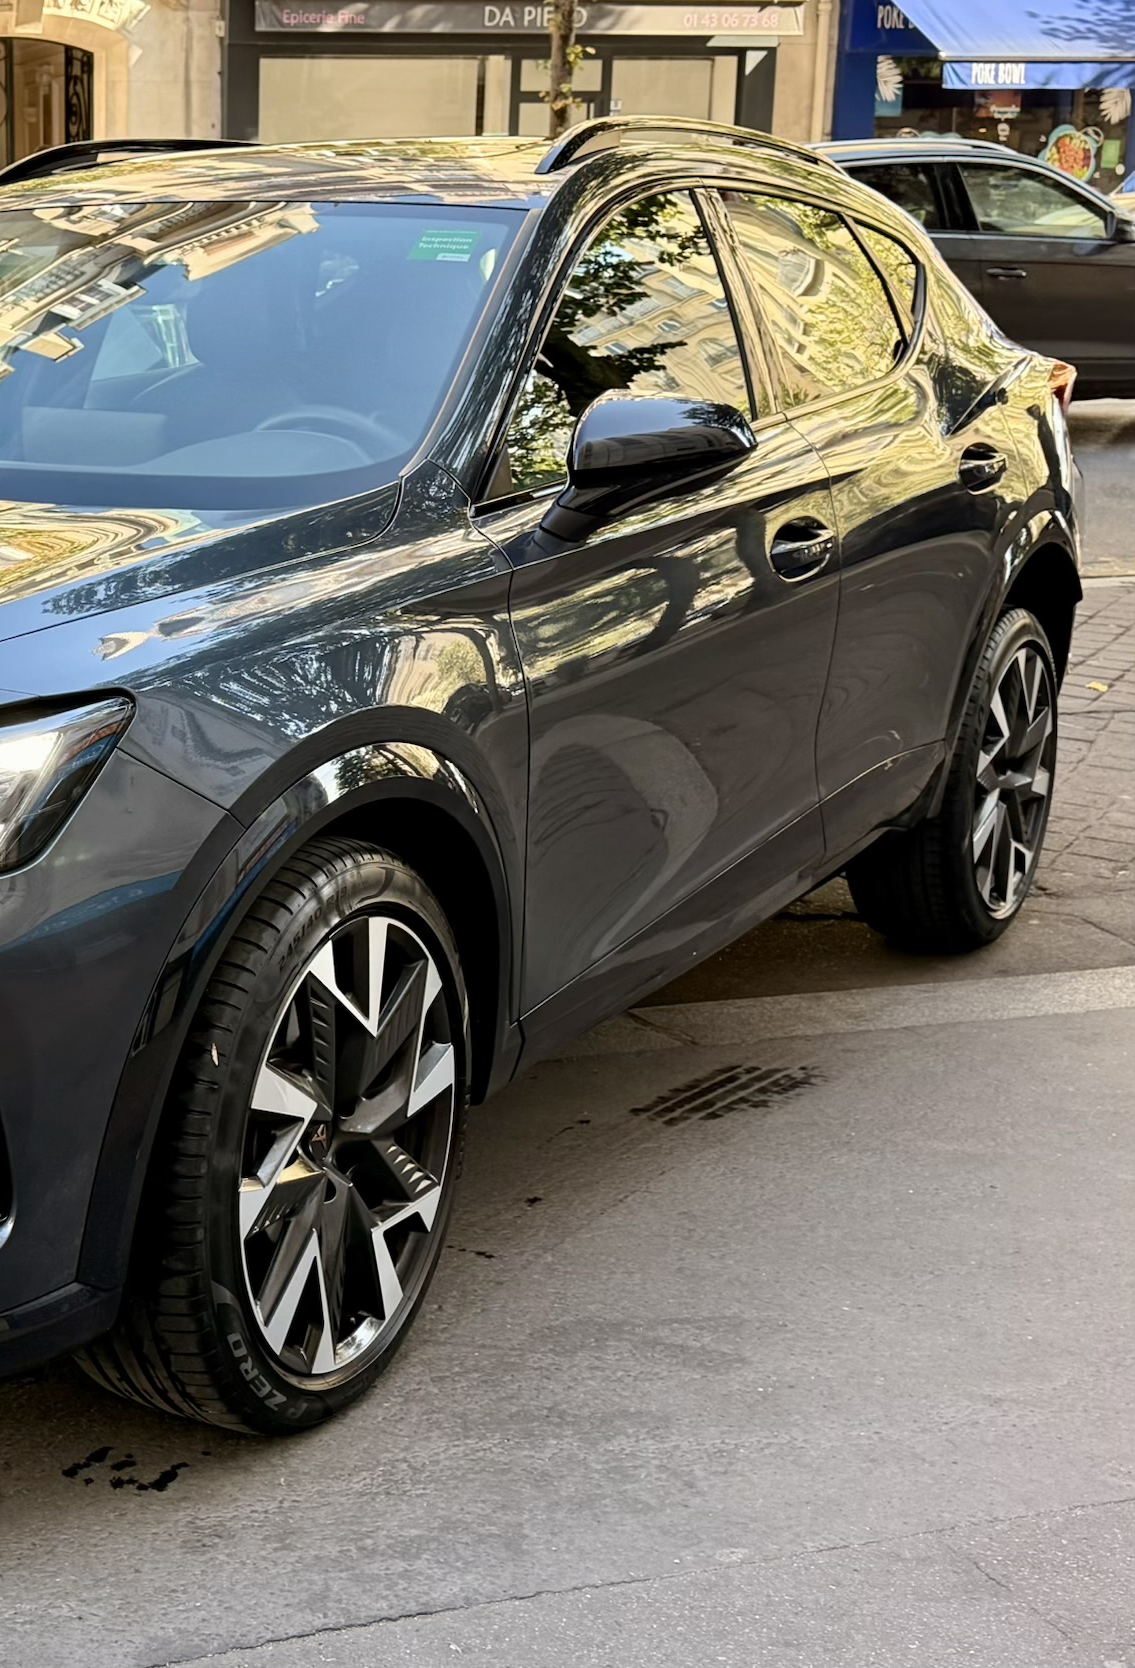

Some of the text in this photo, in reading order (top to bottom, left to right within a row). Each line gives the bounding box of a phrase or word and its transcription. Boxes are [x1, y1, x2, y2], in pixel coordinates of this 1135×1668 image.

[337, 9, 365, 24] Fine
[484, 6, 588, 28] DA PIEO
[684, 14, 779, 28] 01 43 06 73 68
[971, 63, 1026, 85] POKE BOWL
[226, 1332, 288, 1412] ZERO
